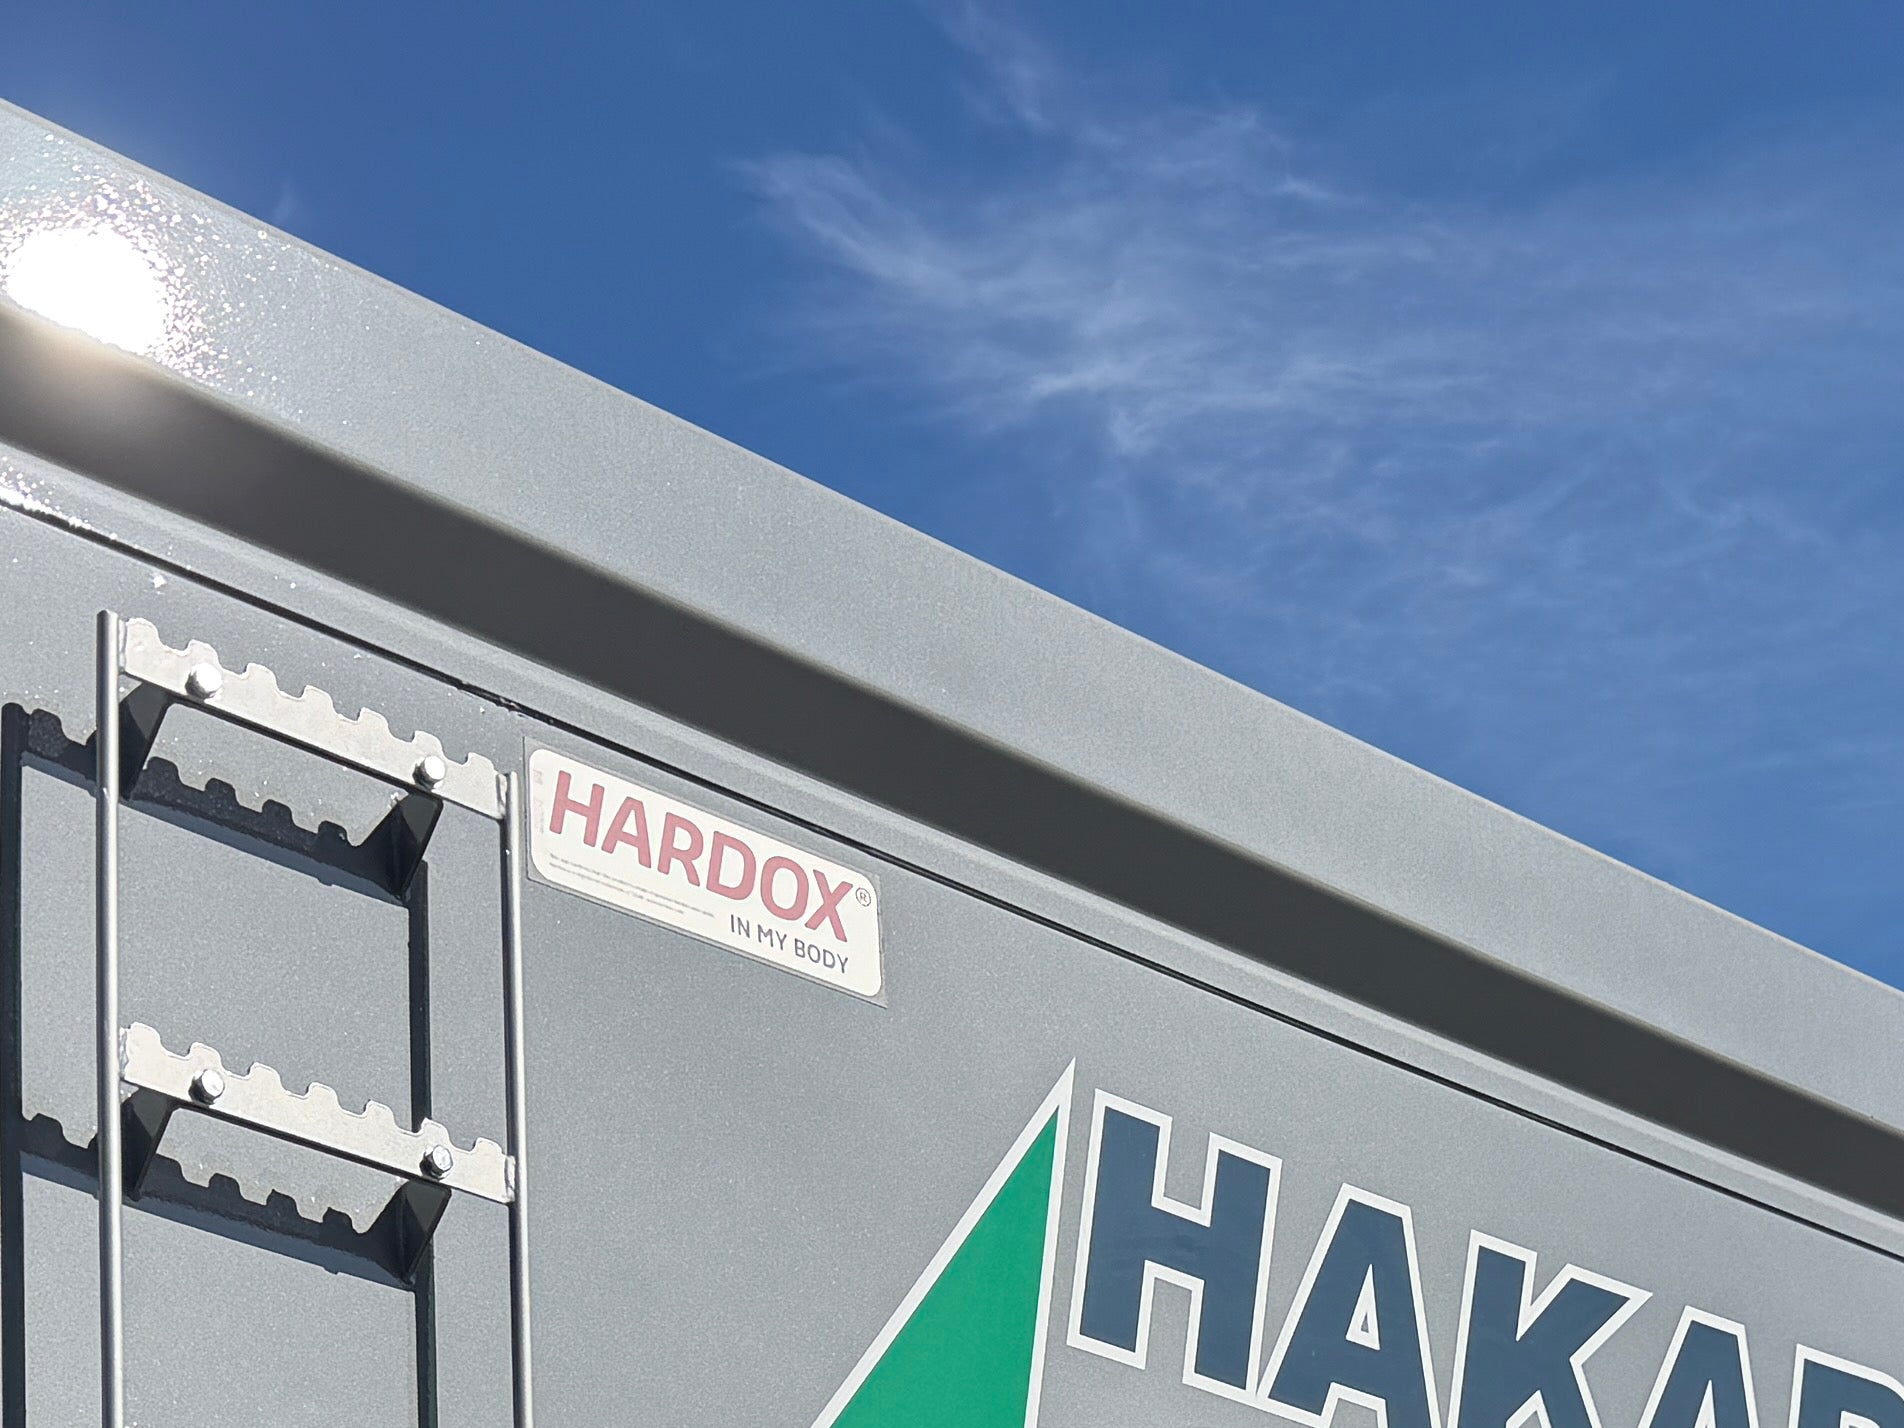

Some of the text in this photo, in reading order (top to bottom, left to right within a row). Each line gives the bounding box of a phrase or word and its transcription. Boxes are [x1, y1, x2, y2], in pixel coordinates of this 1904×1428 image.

[730, 914, 849, 974] IN MY BODY
